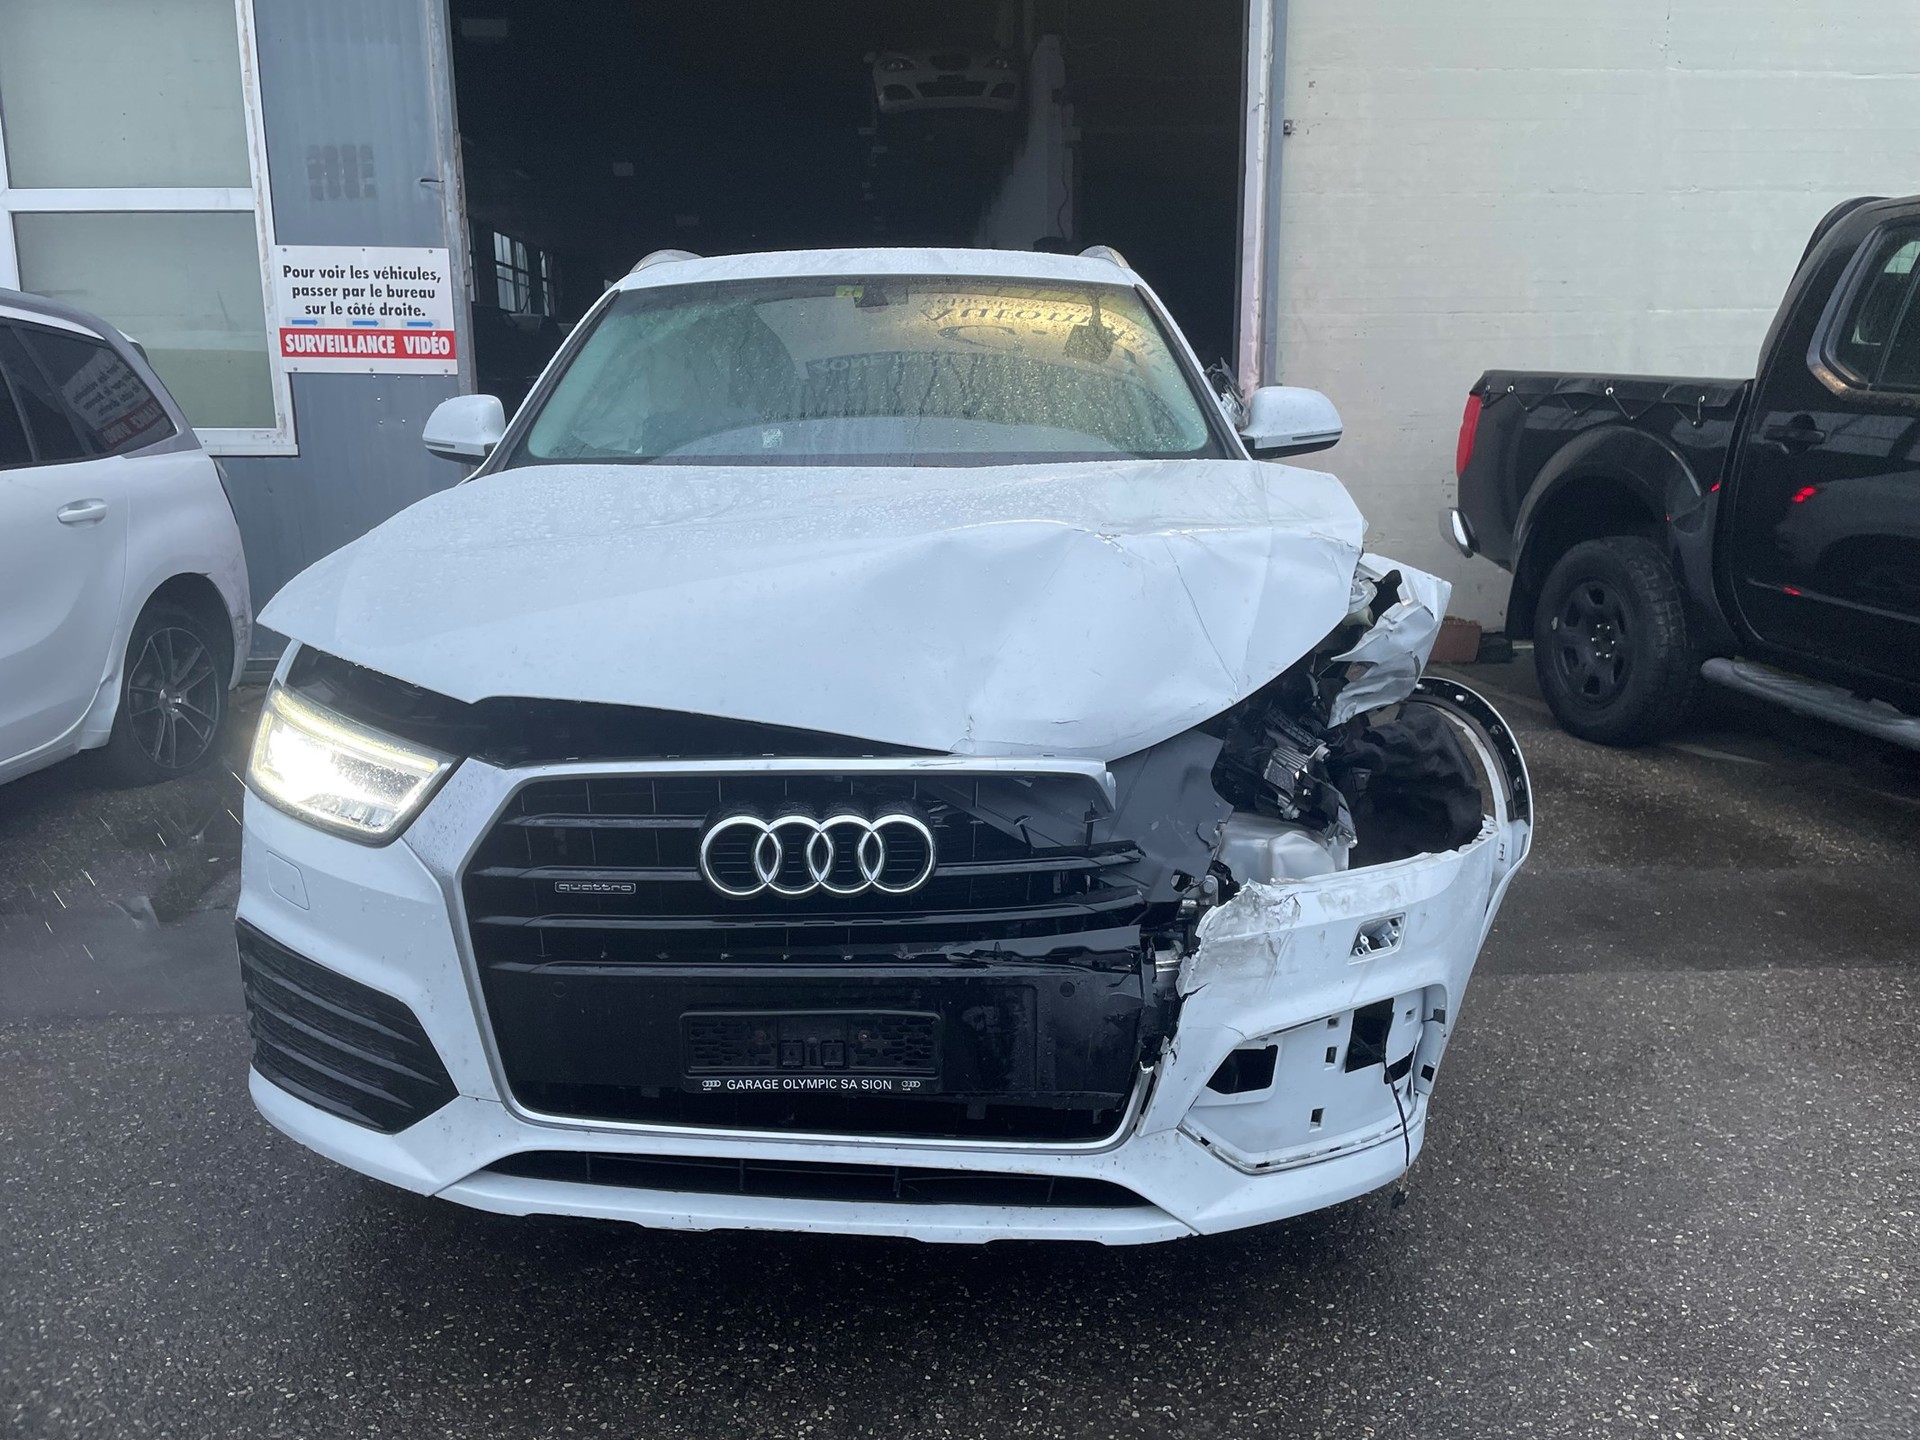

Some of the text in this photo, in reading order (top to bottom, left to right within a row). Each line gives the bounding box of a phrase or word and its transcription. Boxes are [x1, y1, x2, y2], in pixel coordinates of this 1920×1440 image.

[283, 265, 441, 283] Pour voir les véhicules,
[292, 284, 435, 300] passer par le bureau
[305, 302, 426, 317] sur le côté droite.
[285, 331, 450, 355] SURVEILLANCE VIDÉO
[558, 883, 632, 892] quattro
[726, 1078, 892, 1091] GARAGE OLYMPIC SA SION
